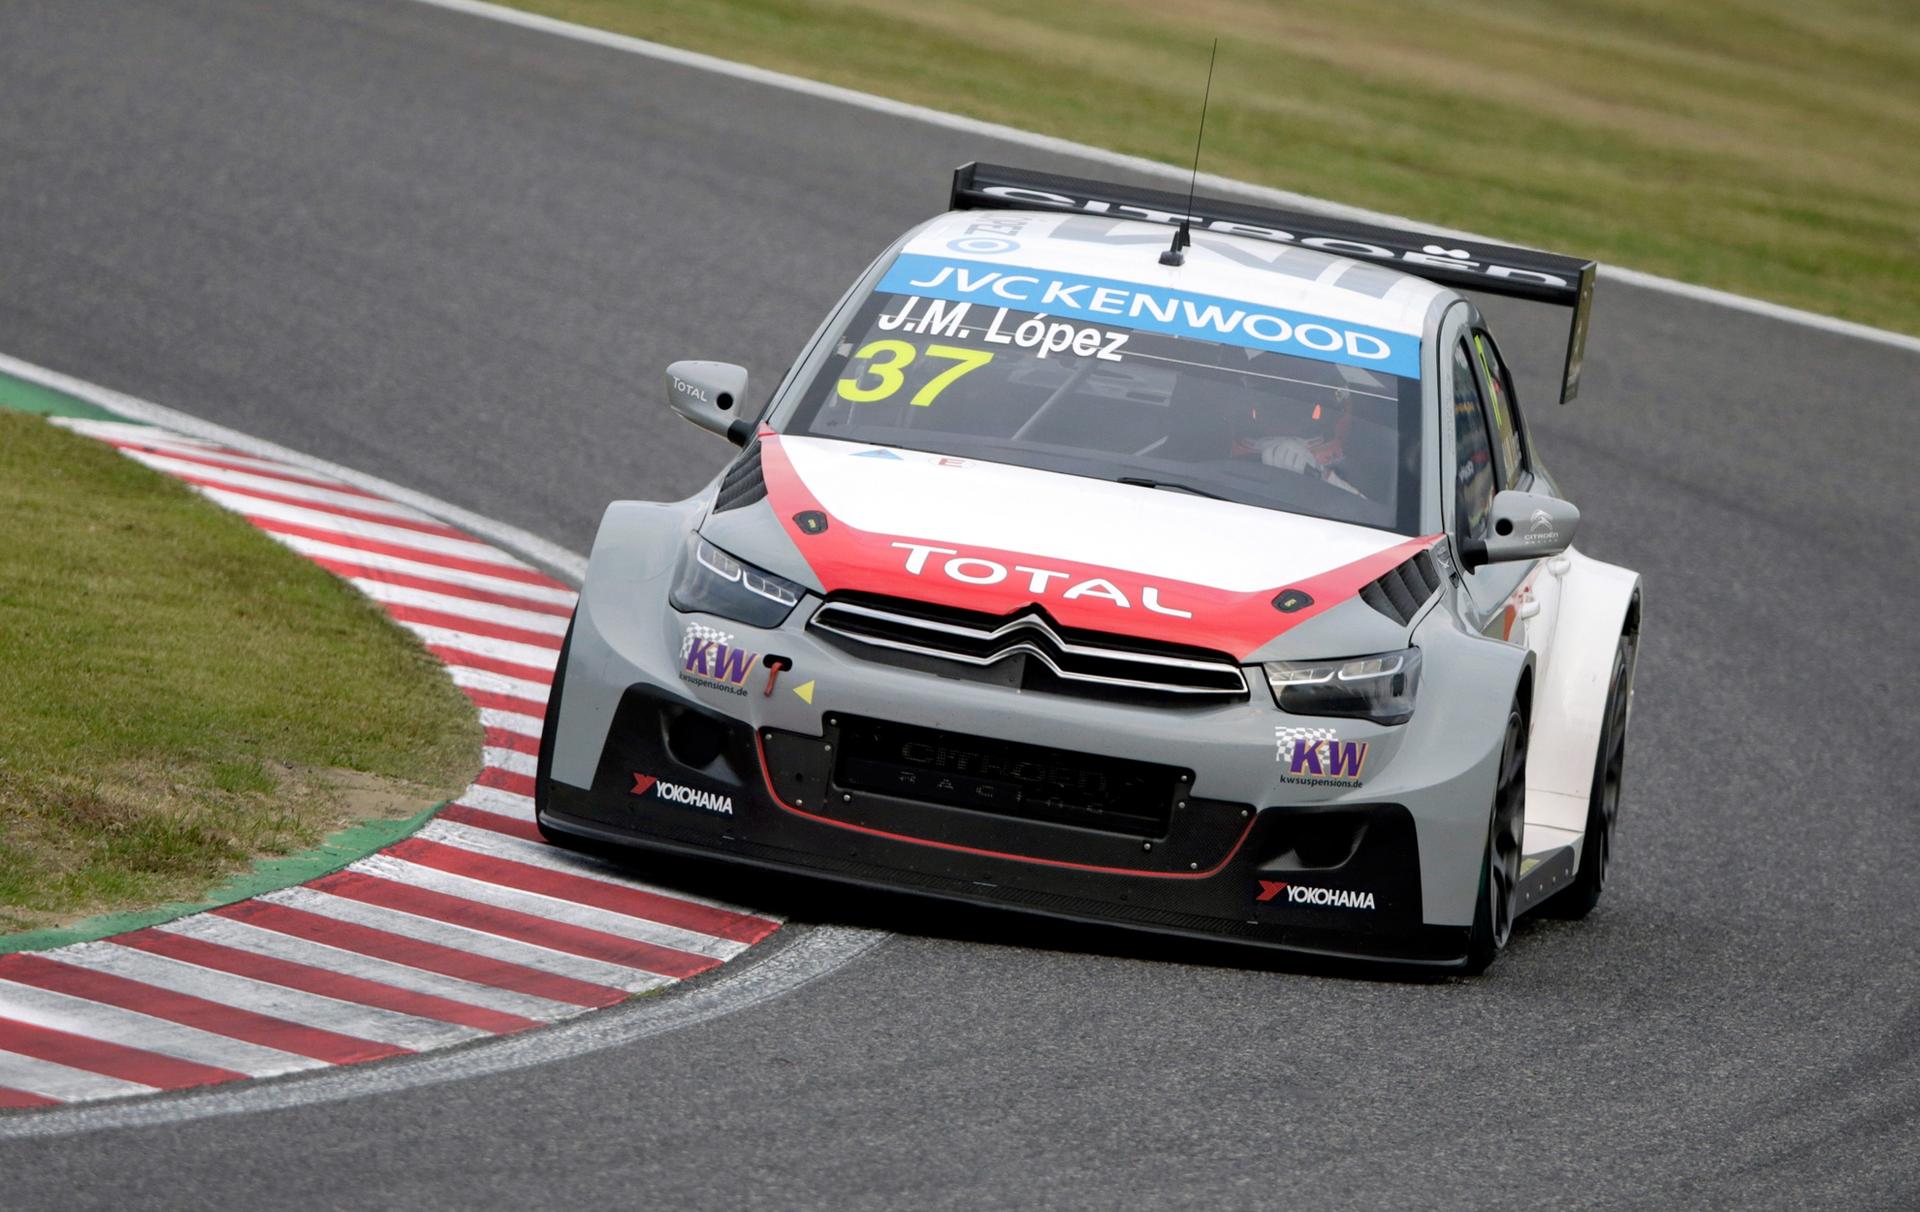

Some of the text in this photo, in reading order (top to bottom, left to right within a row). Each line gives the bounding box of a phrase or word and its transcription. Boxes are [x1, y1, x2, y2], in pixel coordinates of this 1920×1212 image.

[877, 296, 1129, 362] J.M. López
[673, 376, 708, 402] TOTAL
[836, 339, 995, 407] 37
[891, 541, 1192, 619] TOTAL
[686, 637, 760, 687] KW
[679, 671, 748, 697] kwsuspensions.de
[1290, 738, 1368, 779] KW
[656, 780, 734, 815] YOKOHAMA
[1280, 774, 1363, 789] kwsuspensions.de
[1286, 884, 1376, 910] YOKOHAMA
